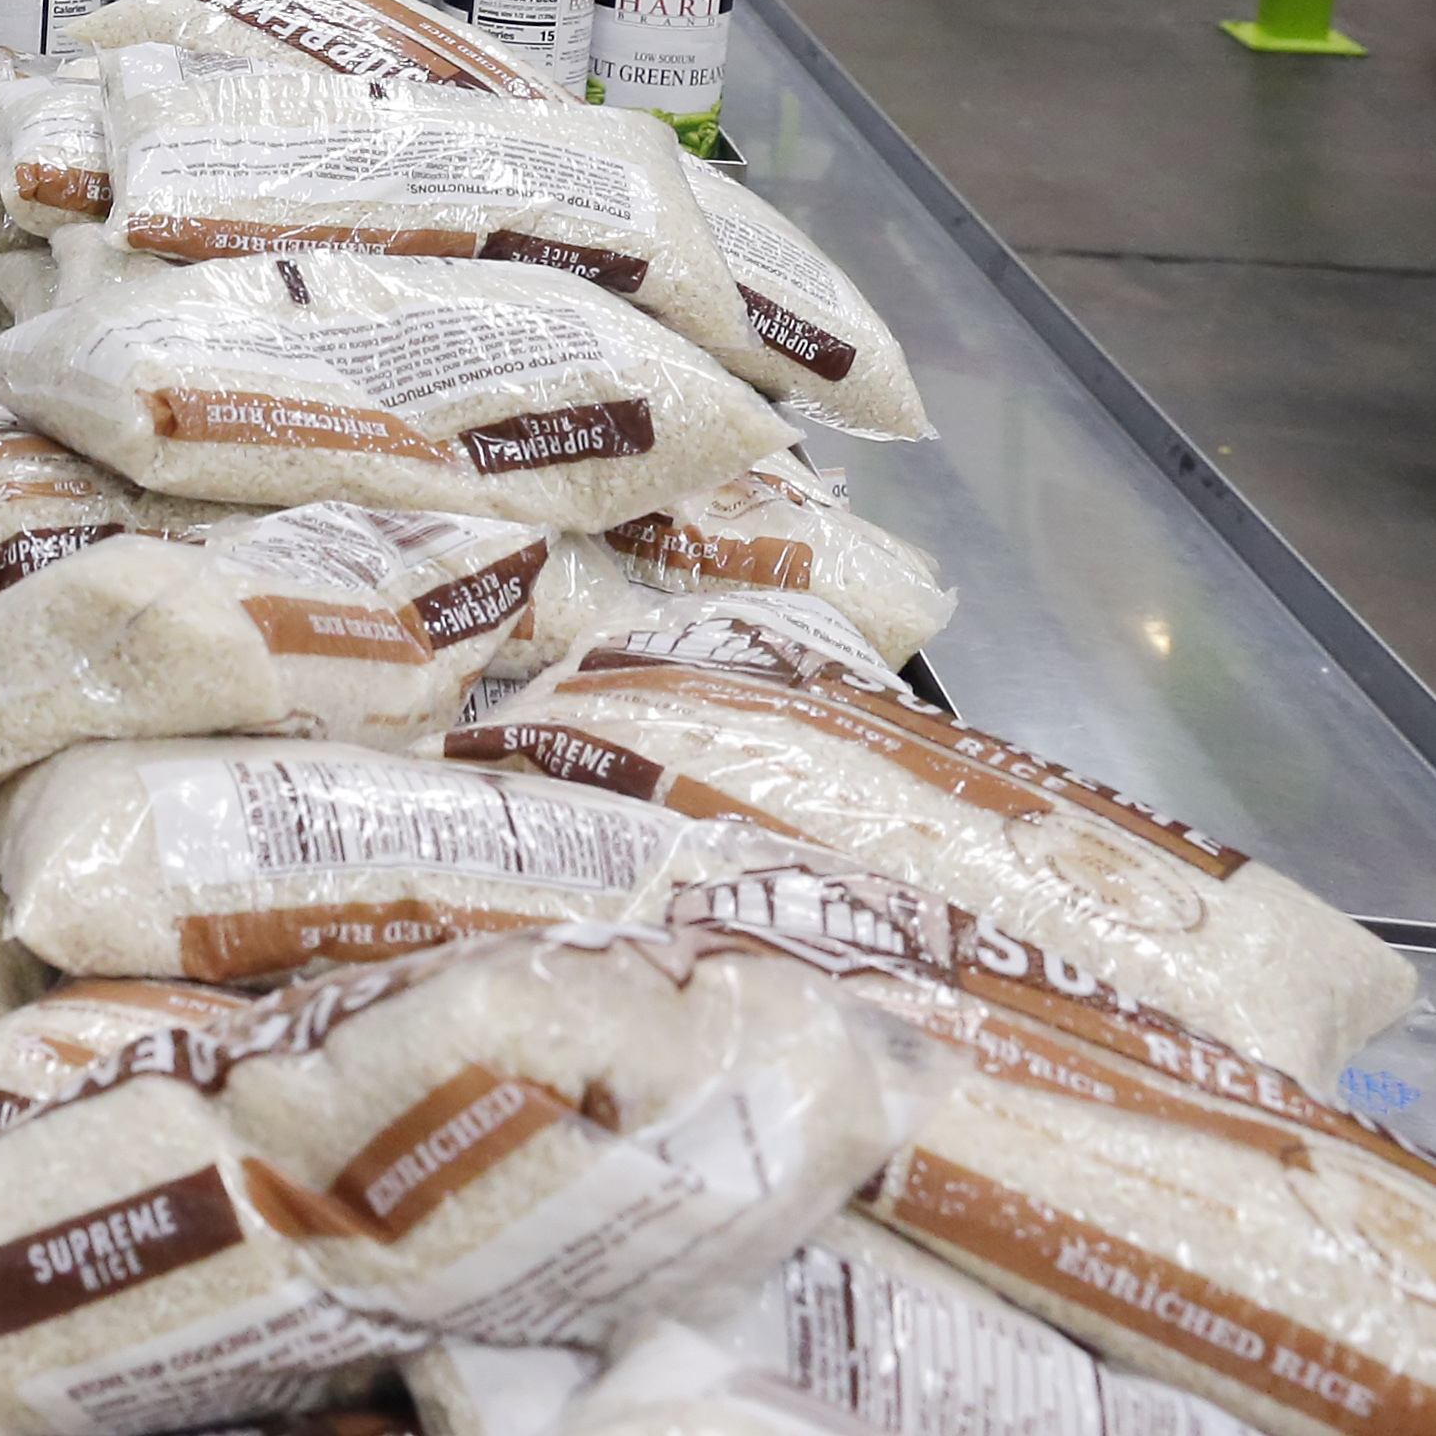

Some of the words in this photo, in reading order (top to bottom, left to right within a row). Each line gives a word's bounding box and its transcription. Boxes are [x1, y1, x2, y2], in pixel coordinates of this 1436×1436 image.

[53, 5, 87, 15] Calories
[617, 12, 716, 28] BRAND
[418, 17, 456, 48] RICE
[540, 30, 555, 42] 15
[633, 51, 656, 62] LOW
[658, 53, 696, 64] SODIUM
[619, 61, 686, 87] GREEN
[689, 64, 726, 88] BEAN
[567, 194, 591, 208] TOP
[214, 231, 266, 251] RICE
[541, 245, 578, 263] RICE
[749, 308, 820, 362] SUPREME
[457, 357, 525, 386] COOKING
[527, 352, 556, 370] TOP
[207, 402, 265, 426] RICE
[270, 408, 389, 438] ENRICHED
[530, 416, 572, 434] RICE
[662, 534, 717, 560] RICE
[462, 572, 499, 602] RICE
[440, 576, 523, 639] SUPREME
[535, 743, 572, 782] RICE
[953, 736, 1070, 792] RICE
[1027, 1049, 1116, 1104] RICE
[1141, 1031, 1298, 1118] RICE
[364, 1079, 526, 1217] ENRICHED
[27, 1194, 178, 1286] SUPREME
[79, 1251, 145, 1292] RICE
[1055, 1241, 1266, 1363] ENRICHED
[1271, 1341, 1378, 1420] RICE
